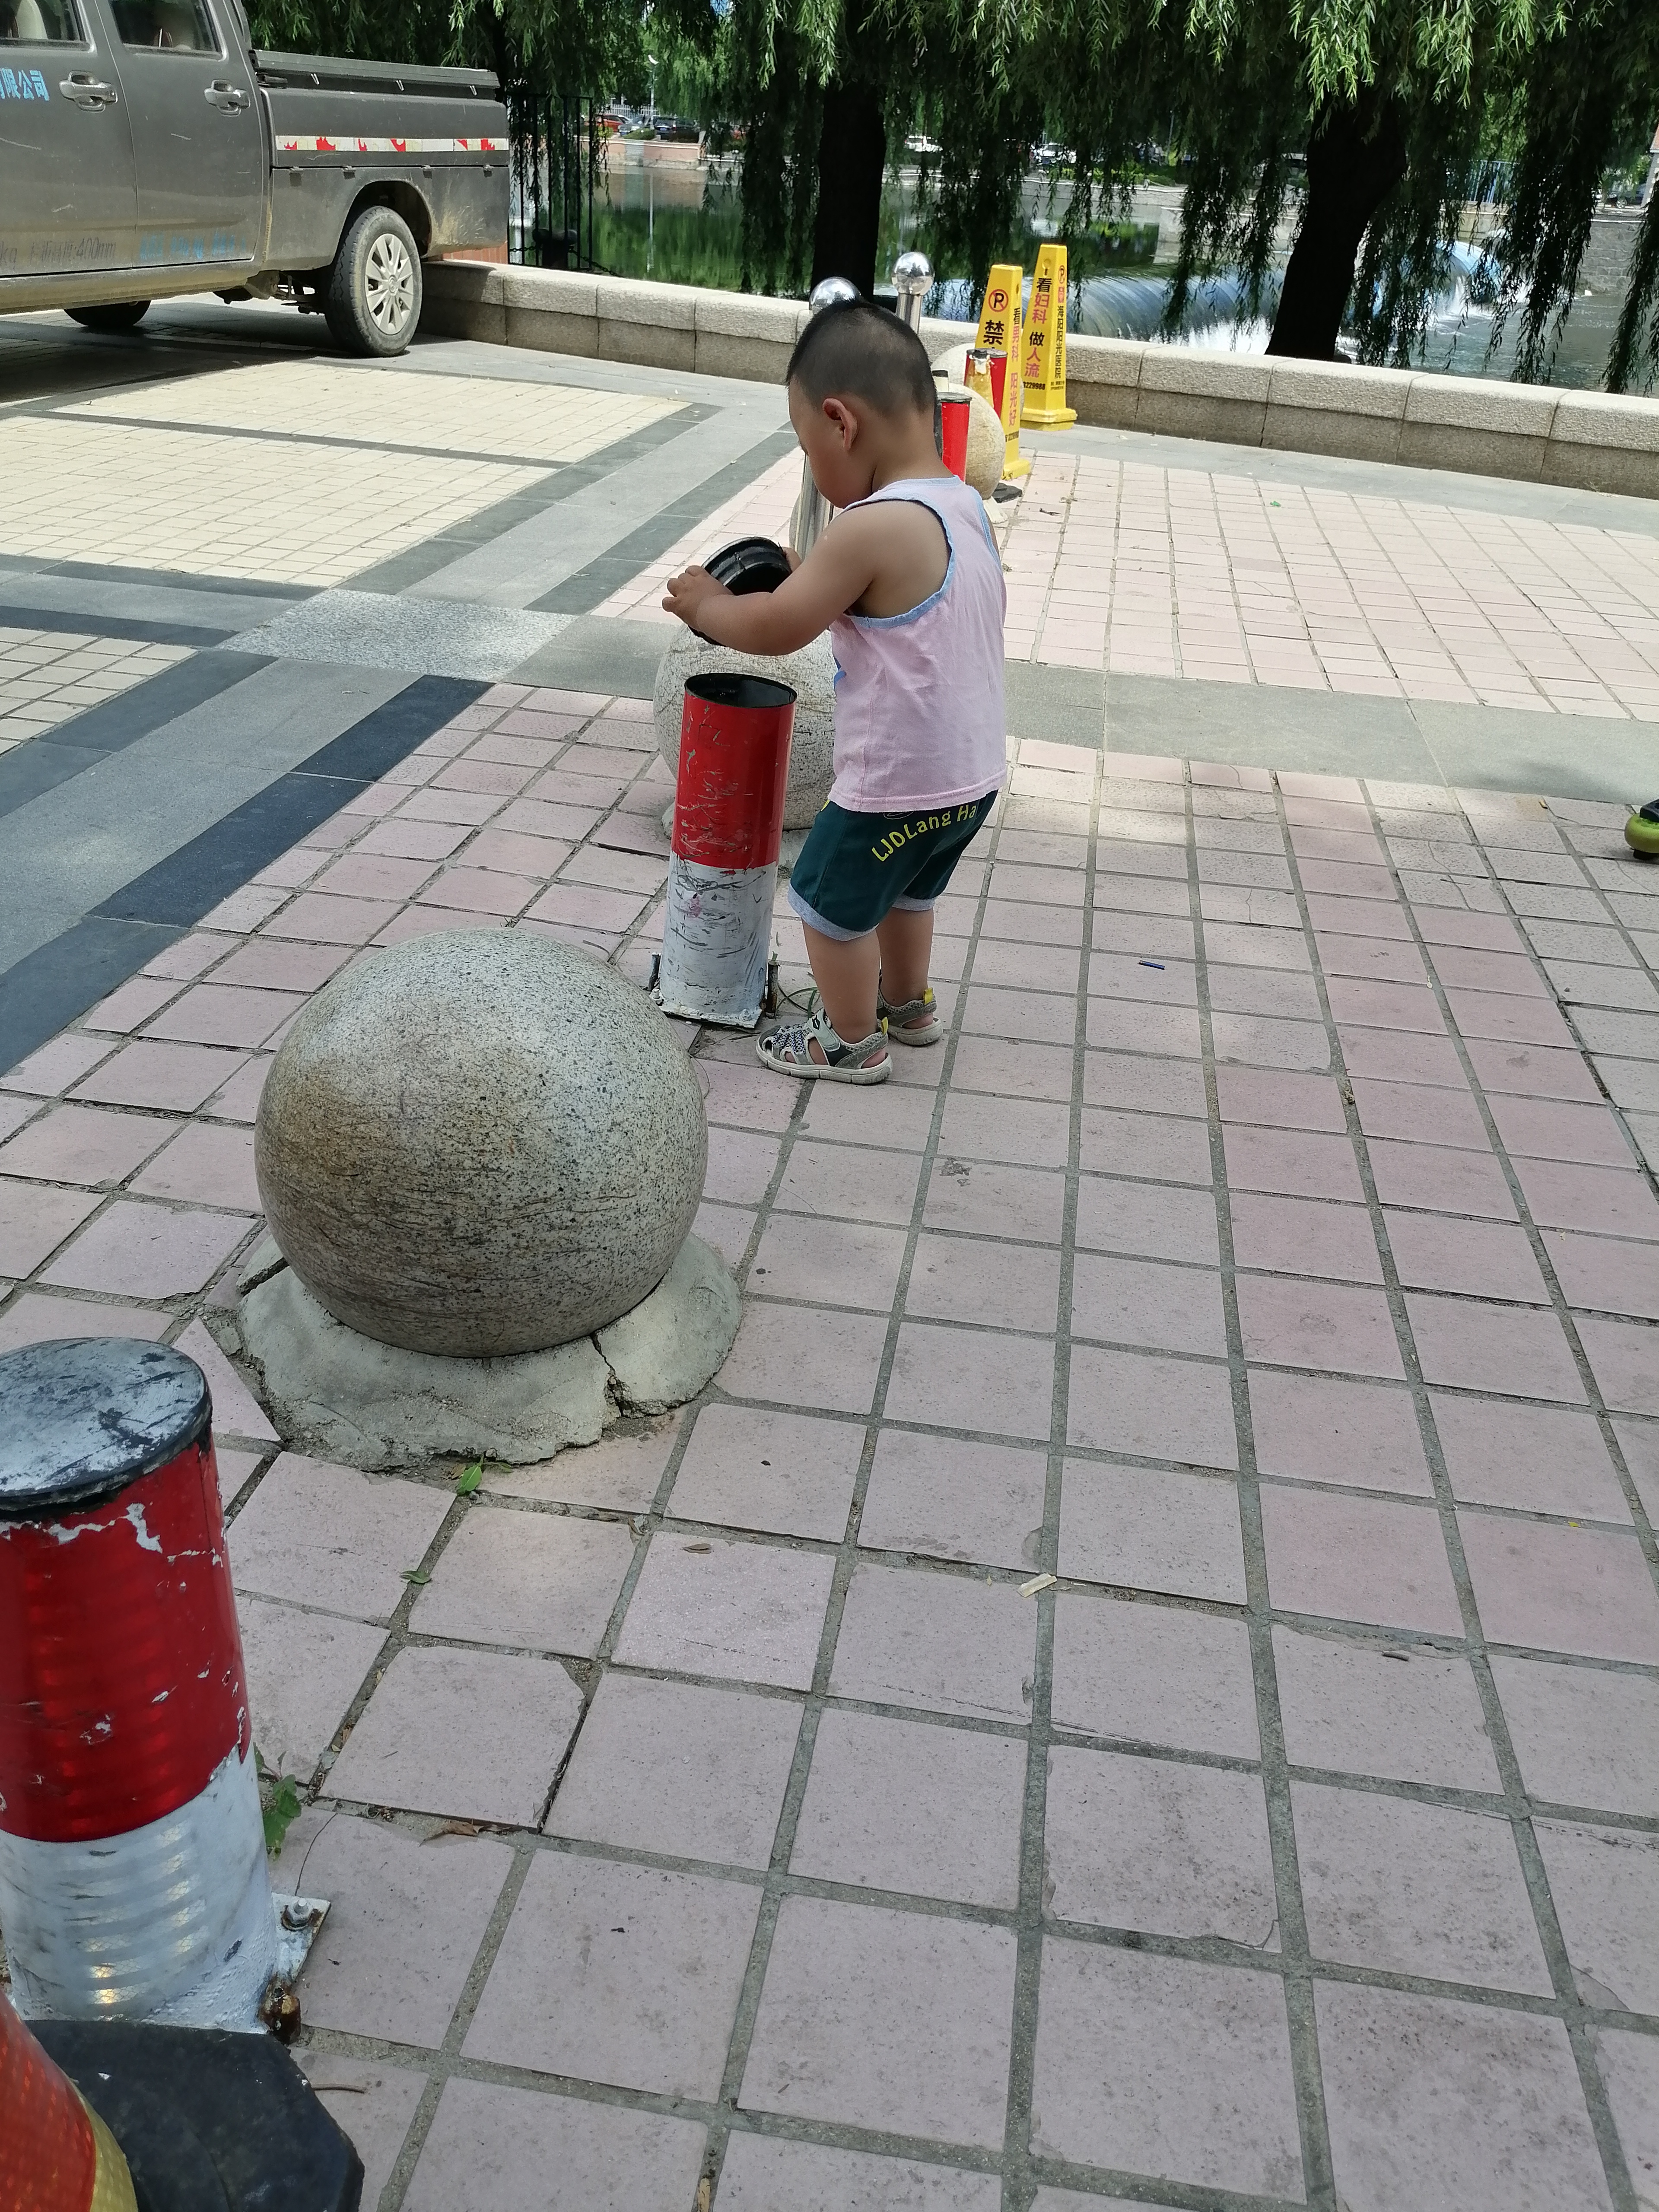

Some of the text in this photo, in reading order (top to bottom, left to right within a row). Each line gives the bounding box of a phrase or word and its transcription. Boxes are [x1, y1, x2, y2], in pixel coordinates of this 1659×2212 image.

[983, 319, 1004, 349] 禁
[1011, 307, 1021, 362] 看男科
[1024, 278, 1052, 378] 看妇科 做人流
[1055, 305, 1064, 379] 海阳阳光医院
[957, 804, 976, 822] Ha
